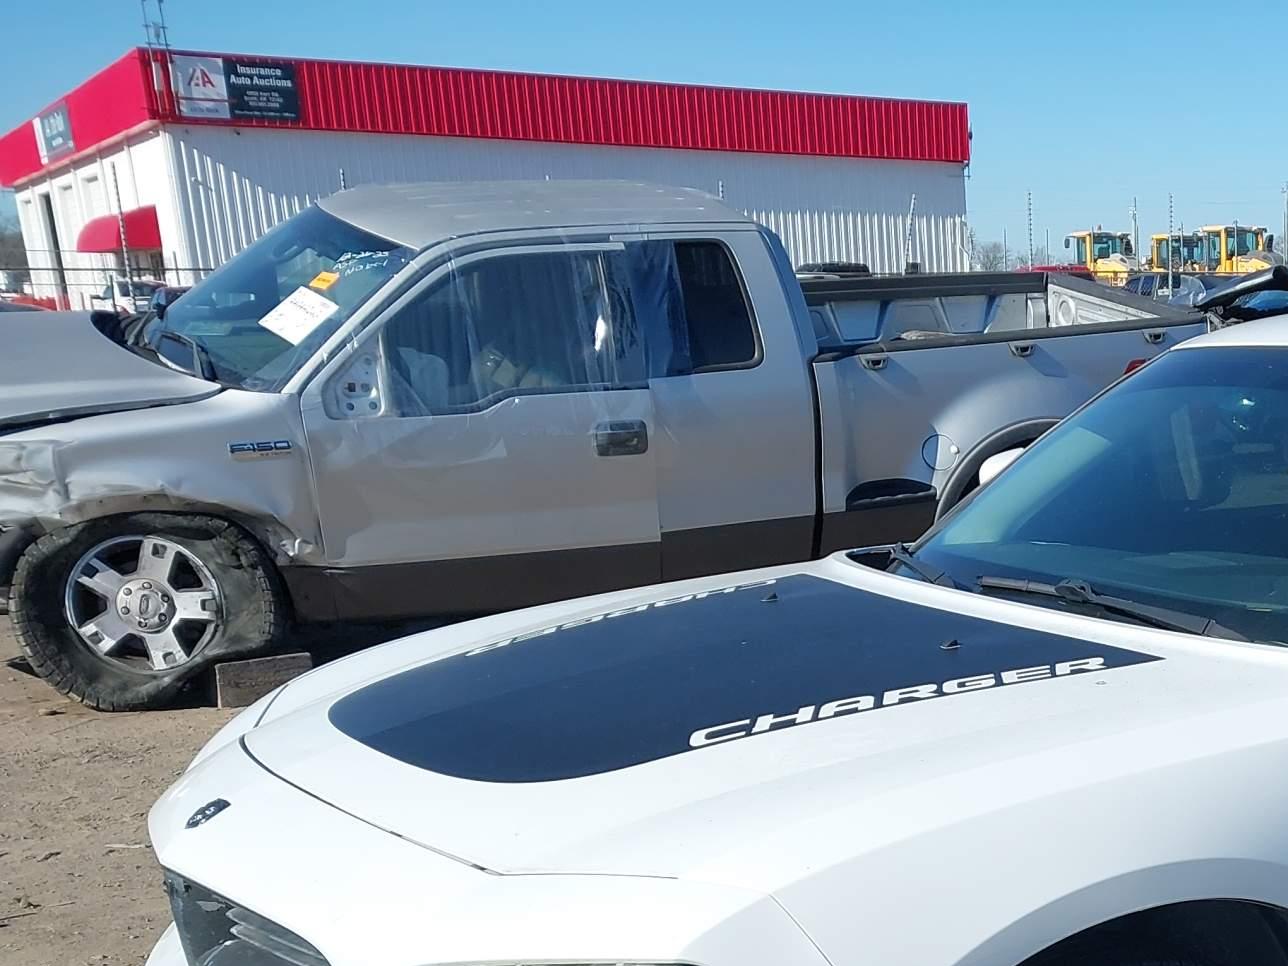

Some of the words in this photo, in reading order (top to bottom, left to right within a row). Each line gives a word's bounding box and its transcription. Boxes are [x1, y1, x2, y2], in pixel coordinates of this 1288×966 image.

[236, 64, 283, 76] Insurance
[229, 74, 251, 86] Auto
[252, 76, 293, 88] Auctions
[688, 656, 1107, 749] CHARGER
